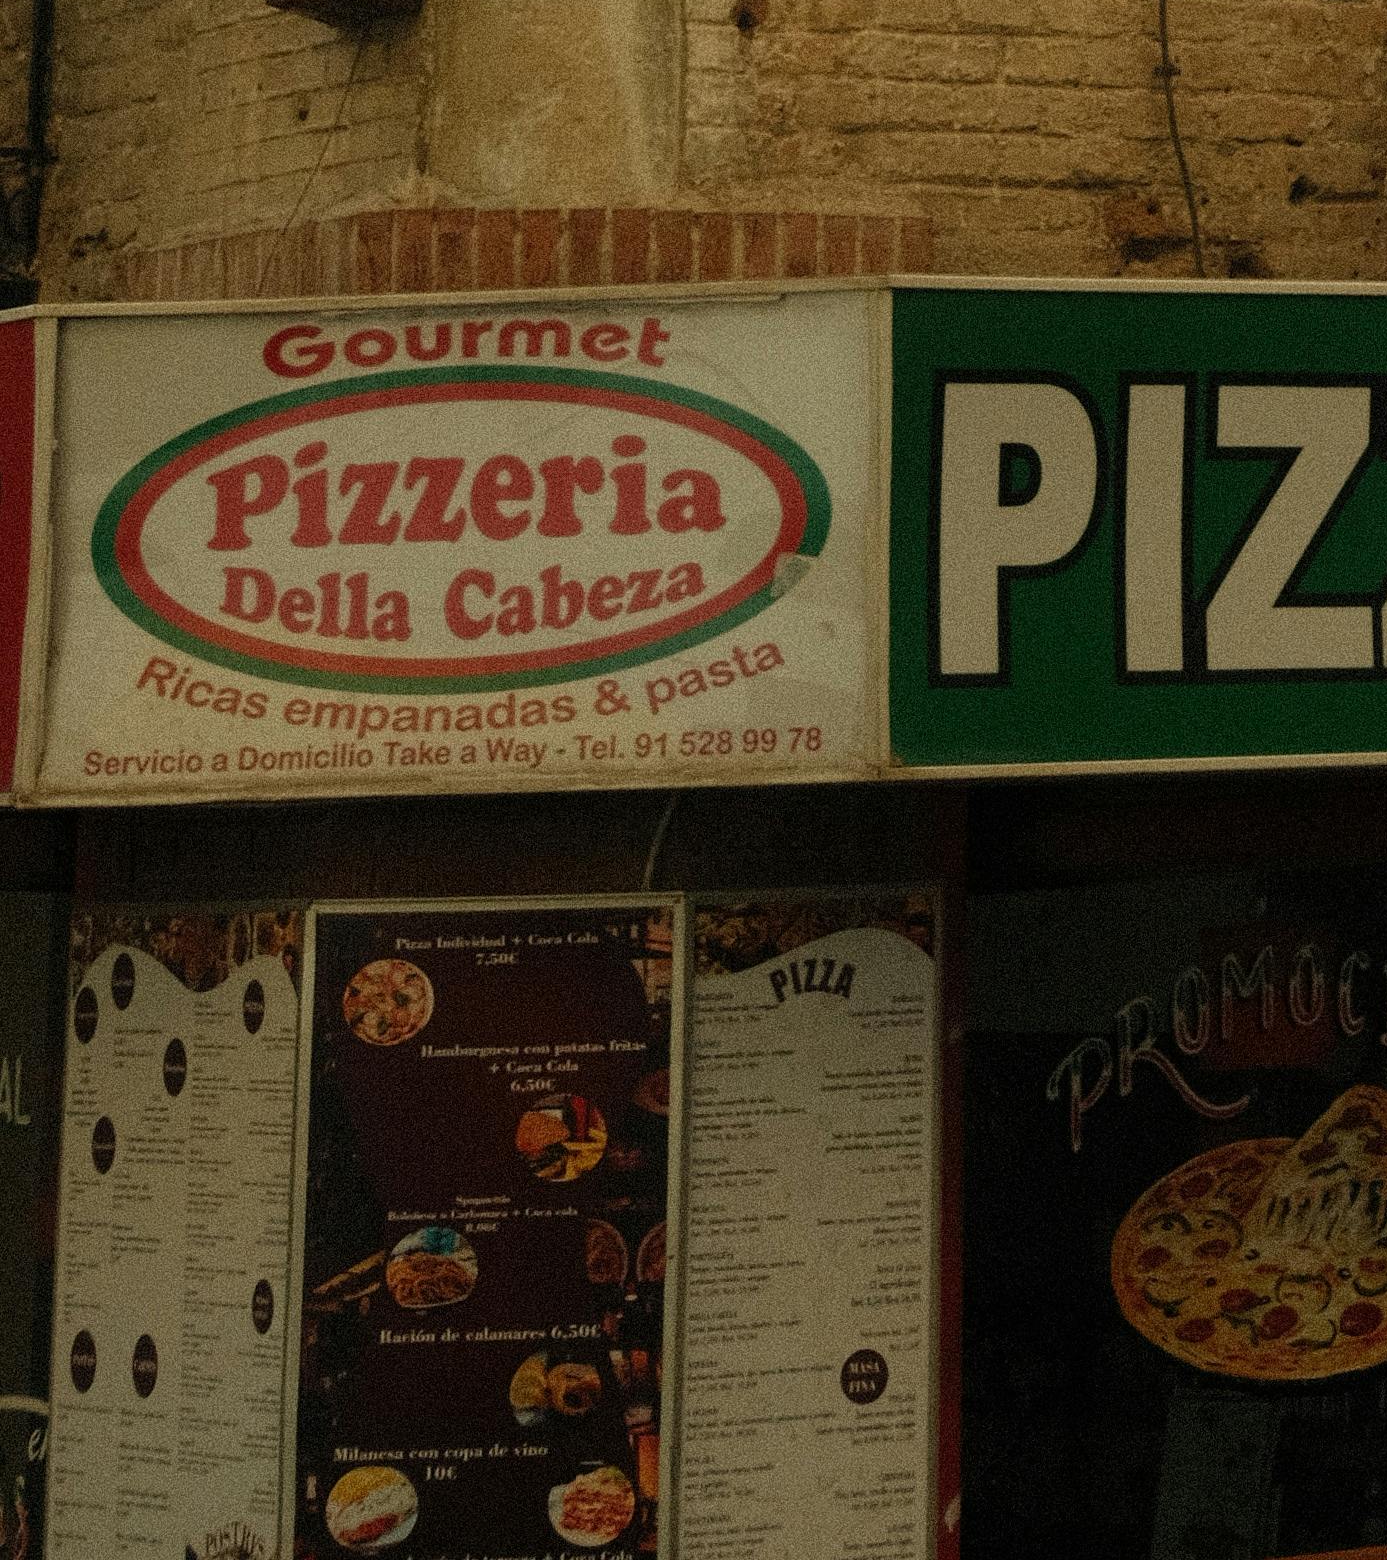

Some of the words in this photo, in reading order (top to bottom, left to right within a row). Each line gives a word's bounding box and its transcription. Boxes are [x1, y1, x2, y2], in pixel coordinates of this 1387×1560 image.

[262, 318, 671, 379] Gourmet
[205, 435, 727, 551] Pizzeria
[219, 566, 413, 642] Della
[443, 561, 706, 641] Cabeza
[136, 656, 270, 720] Ricas
[283, 693, 578, 740] empanadas
[594, 679, 632, 717] &
[645, 641, 786, 715] pasta
[84, 749, 204, 777] Servicio
[210, 752, 229, 773] a
[237, 745, 374, 772] Domicilio
[383, 741, 451, 767] Take
[460, 744, 477, 765] a
[486, 738, 549, 769] Way
[574, 734, 625, 760] Tel.
[634, 731, 668, 758] 91
[680, 729, 733, 756] 528
[742, 728, 778, 755] 99
[788, 726, 822, 753] 78
[395, 937, 432, 951] Pizza
[436, 934, 506, 950] Individual
[527, 933, 563, 946] Coca
[566, 931, 599, 945] Cola
[770, 958, 856, 1004] PIZZA
[506, 1061, 543, 1074] Coca
[546, 1060, 580, 1073] Cola
[523, 1044, 551, 1055] con
[609, 1039, 648, 1052] fritas
[378, 1327, 436, 1345] Ración
[440, 1328, 461, 1343] de
[464, 1327, 547, 1343] calamares
[332, 1445, 405, 1463] Milanesa
[408, 1448, 439, 1460] con
[443, 1447, 483, 1462] copa
[488, 1443, 510, 1458] de
[512, 1442, 549, 1457] vino
